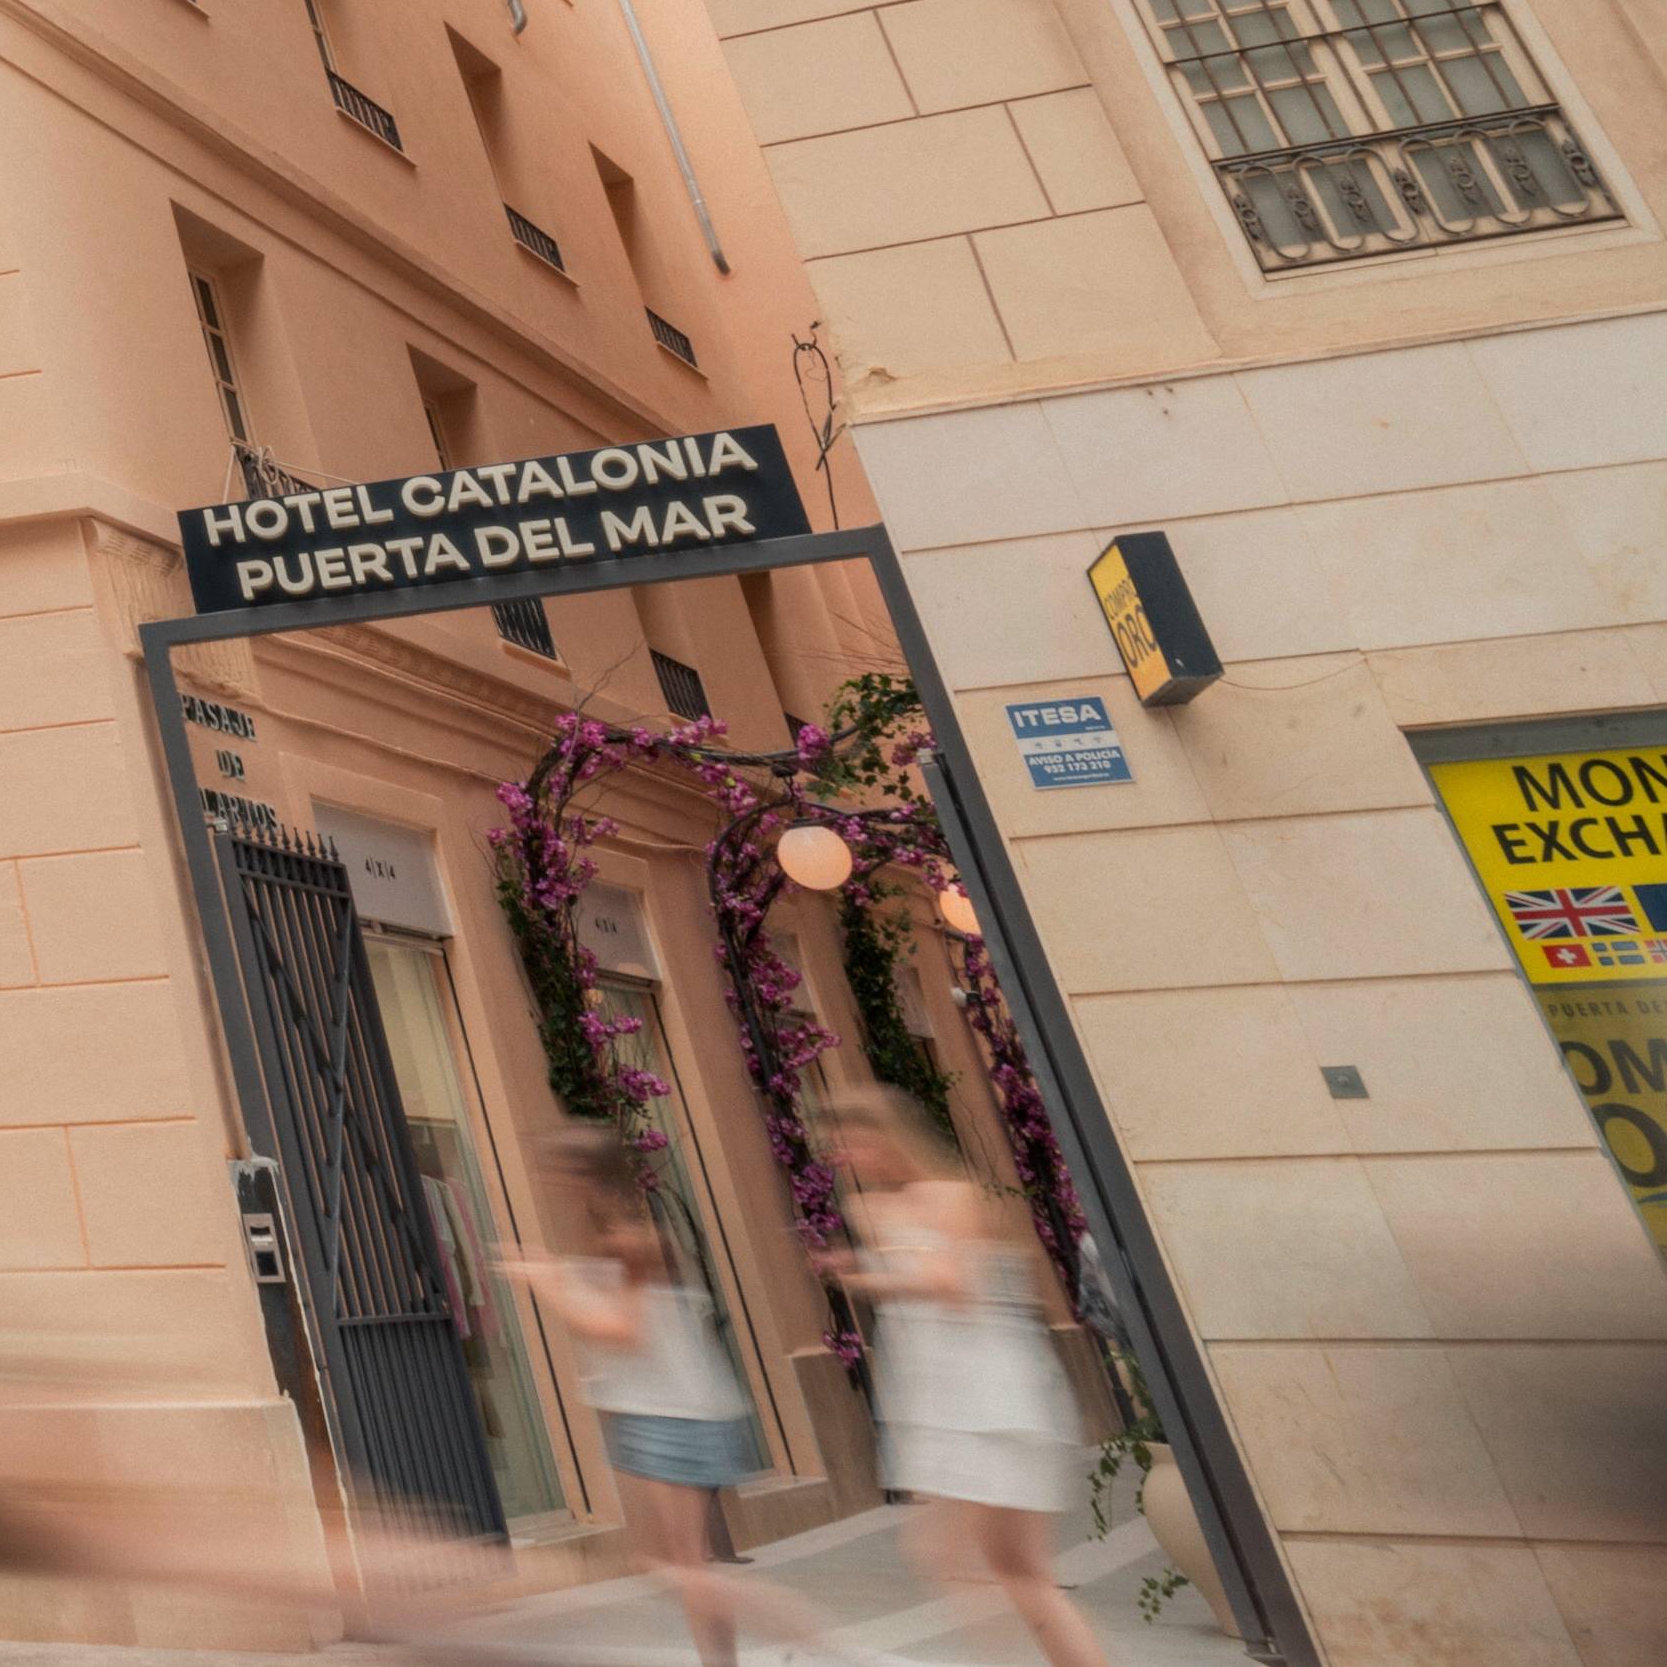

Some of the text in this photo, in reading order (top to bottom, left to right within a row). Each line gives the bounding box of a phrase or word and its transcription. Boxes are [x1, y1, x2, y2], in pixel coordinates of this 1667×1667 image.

[203, 432, 759, 547] HOTEL CATALONIA
[236, 494, 756, 600] PUERTA DEL MAR
[181, 693, 257, 742] PASAJE
[1013, 704, 1102, 728] ITESA
[216, 749, 245, 782] DE
[1029, 749, 1121, 767] AVISO A POLICÍA
[1044, 764, 1066, 774] 952
[1491, 813, 1667, 865] EXCH
[1548, 1000, 1667, 1018] PUERTA DE
